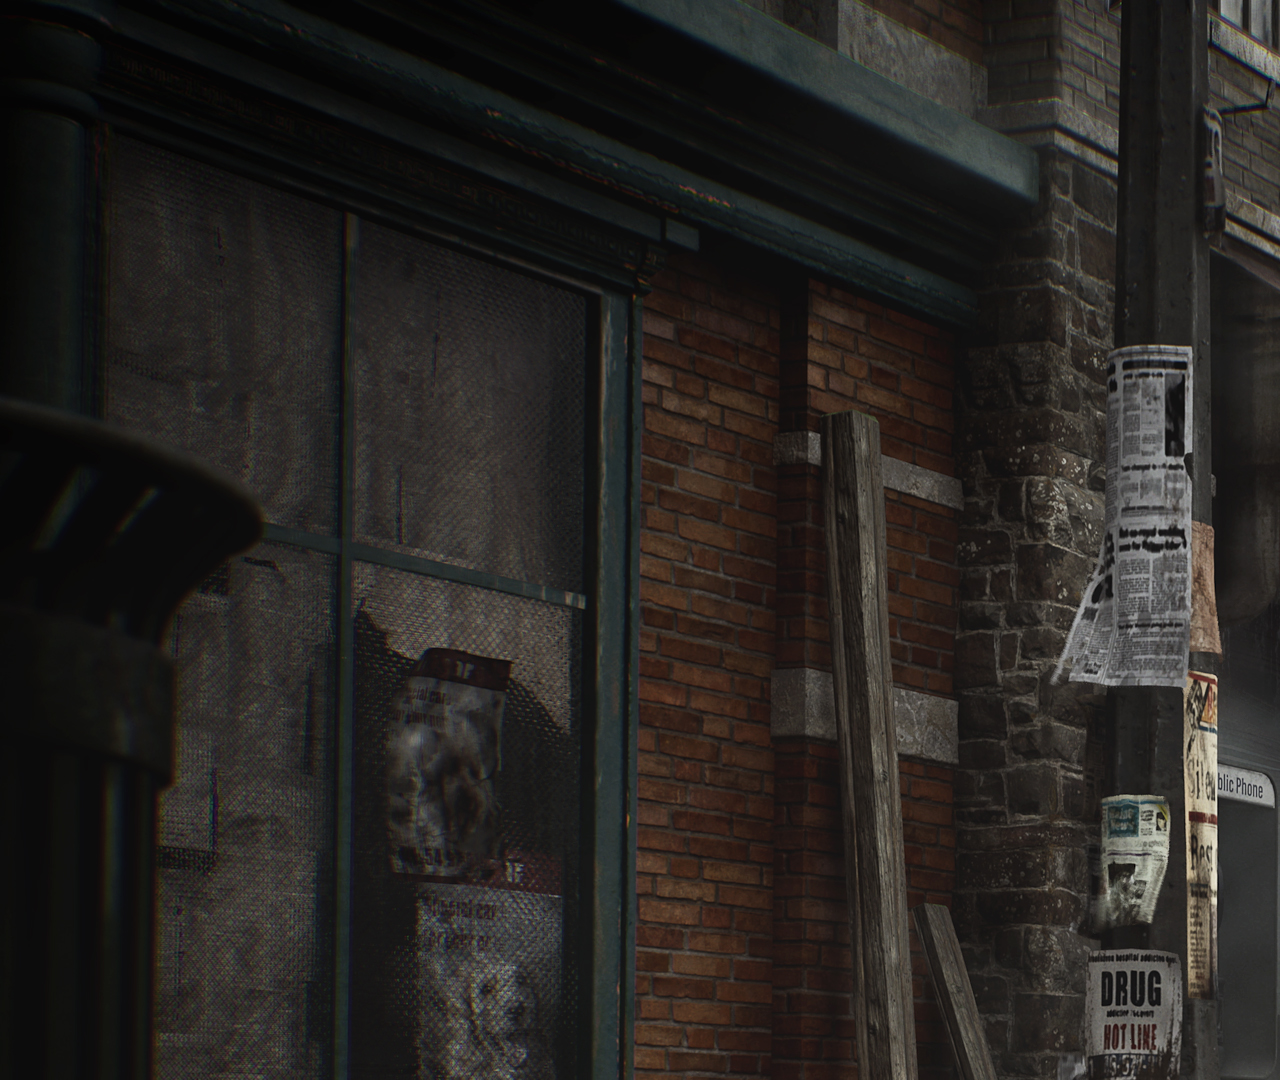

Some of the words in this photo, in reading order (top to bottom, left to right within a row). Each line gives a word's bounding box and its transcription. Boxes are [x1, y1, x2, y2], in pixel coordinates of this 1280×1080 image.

[1218, 772, 1234, 793] blic
[1236, 777, 1264, 799] Phone
[1101, 970, 1161, 1007] DRUG
[1104, 1023, 1127, 1050] HOT
[1130, 1023, 1157, 1051] LINE
